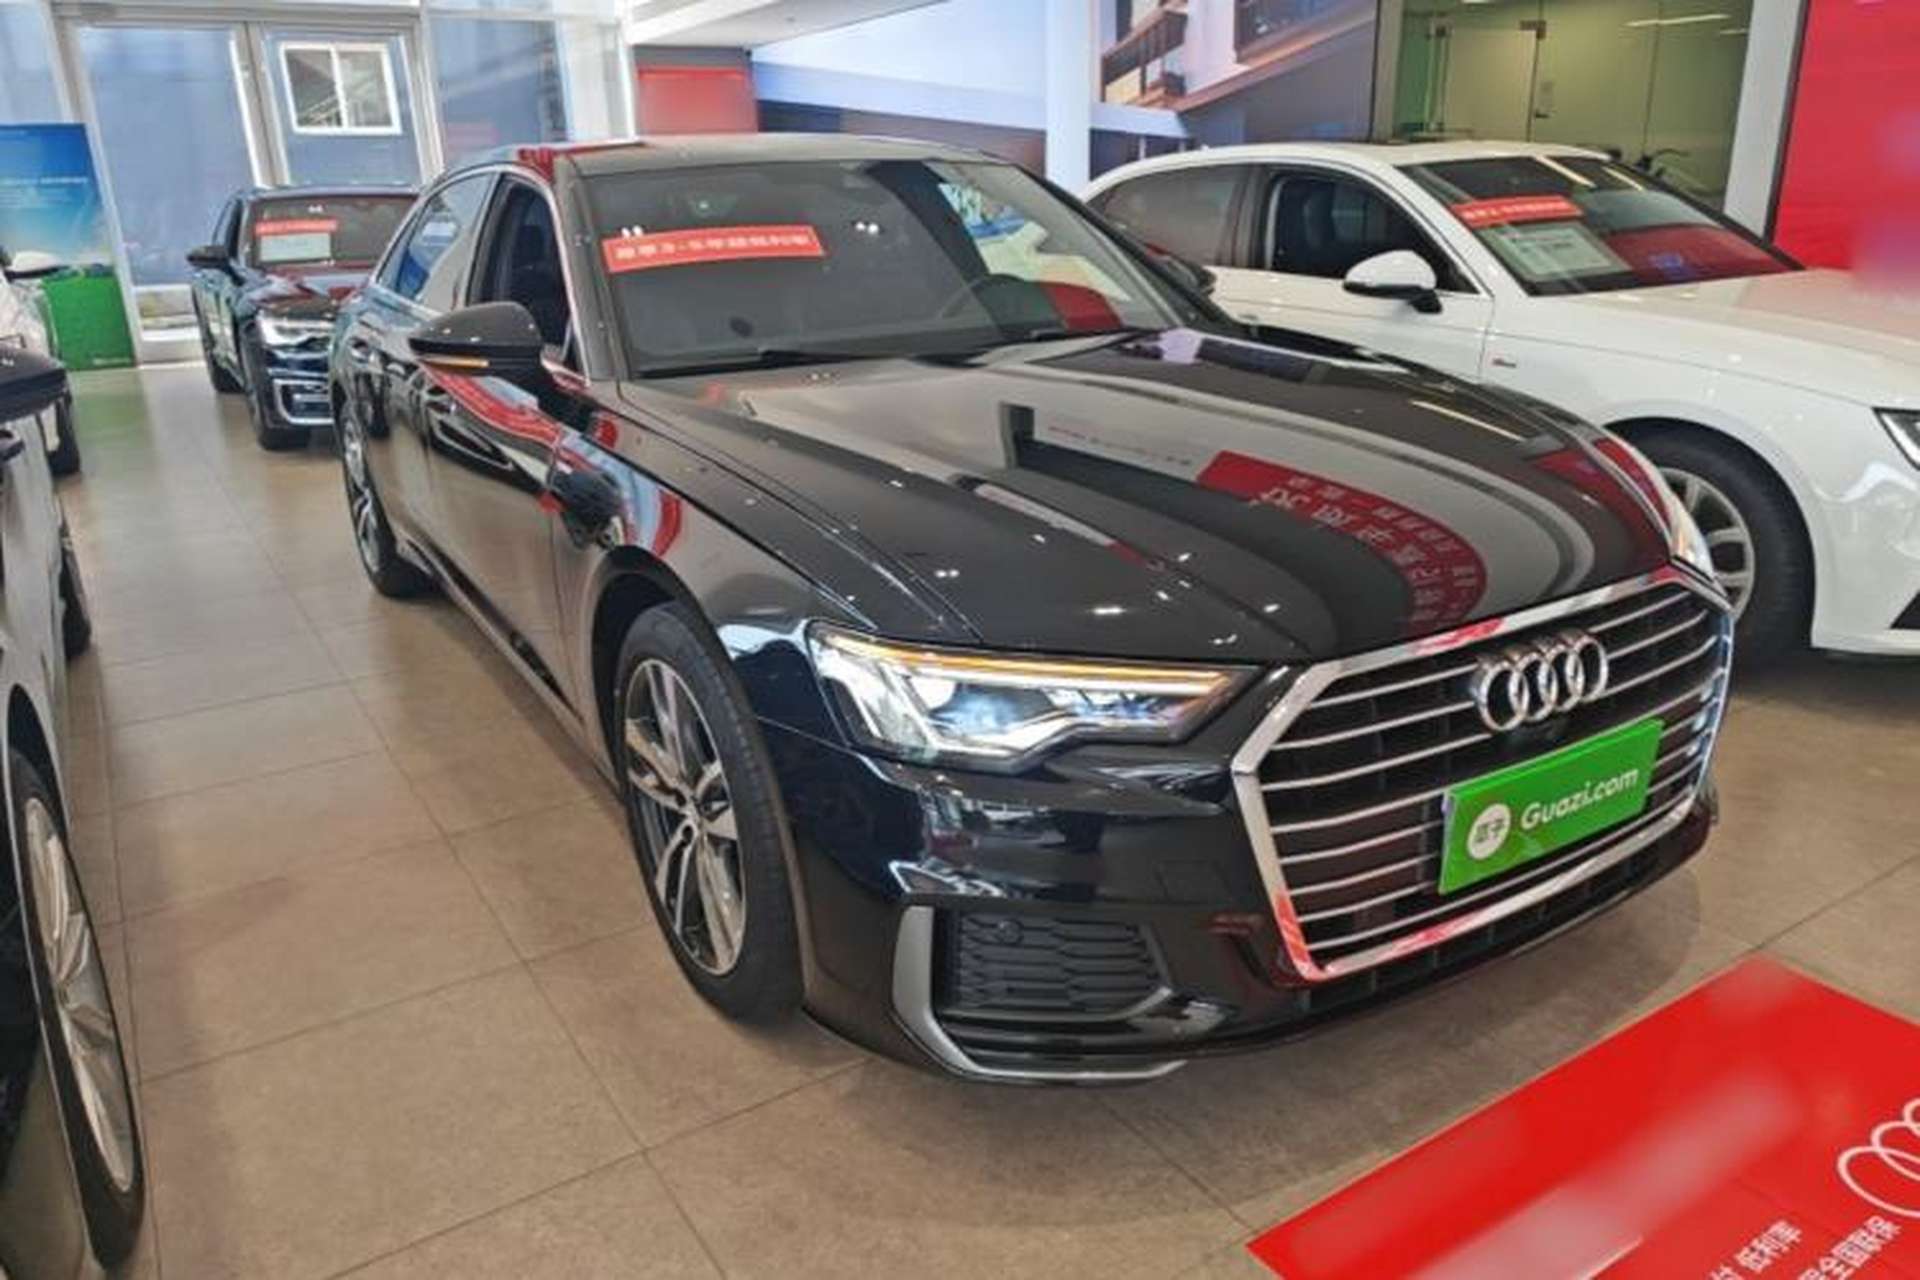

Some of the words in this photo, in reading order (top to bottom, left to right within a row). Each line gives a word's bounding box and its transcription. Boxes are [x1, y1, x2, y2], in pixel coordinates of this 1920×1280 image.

[1520, 768, 1639, 831] Guazi.com
[1735, 1219, 1802, 1274] 低利率
